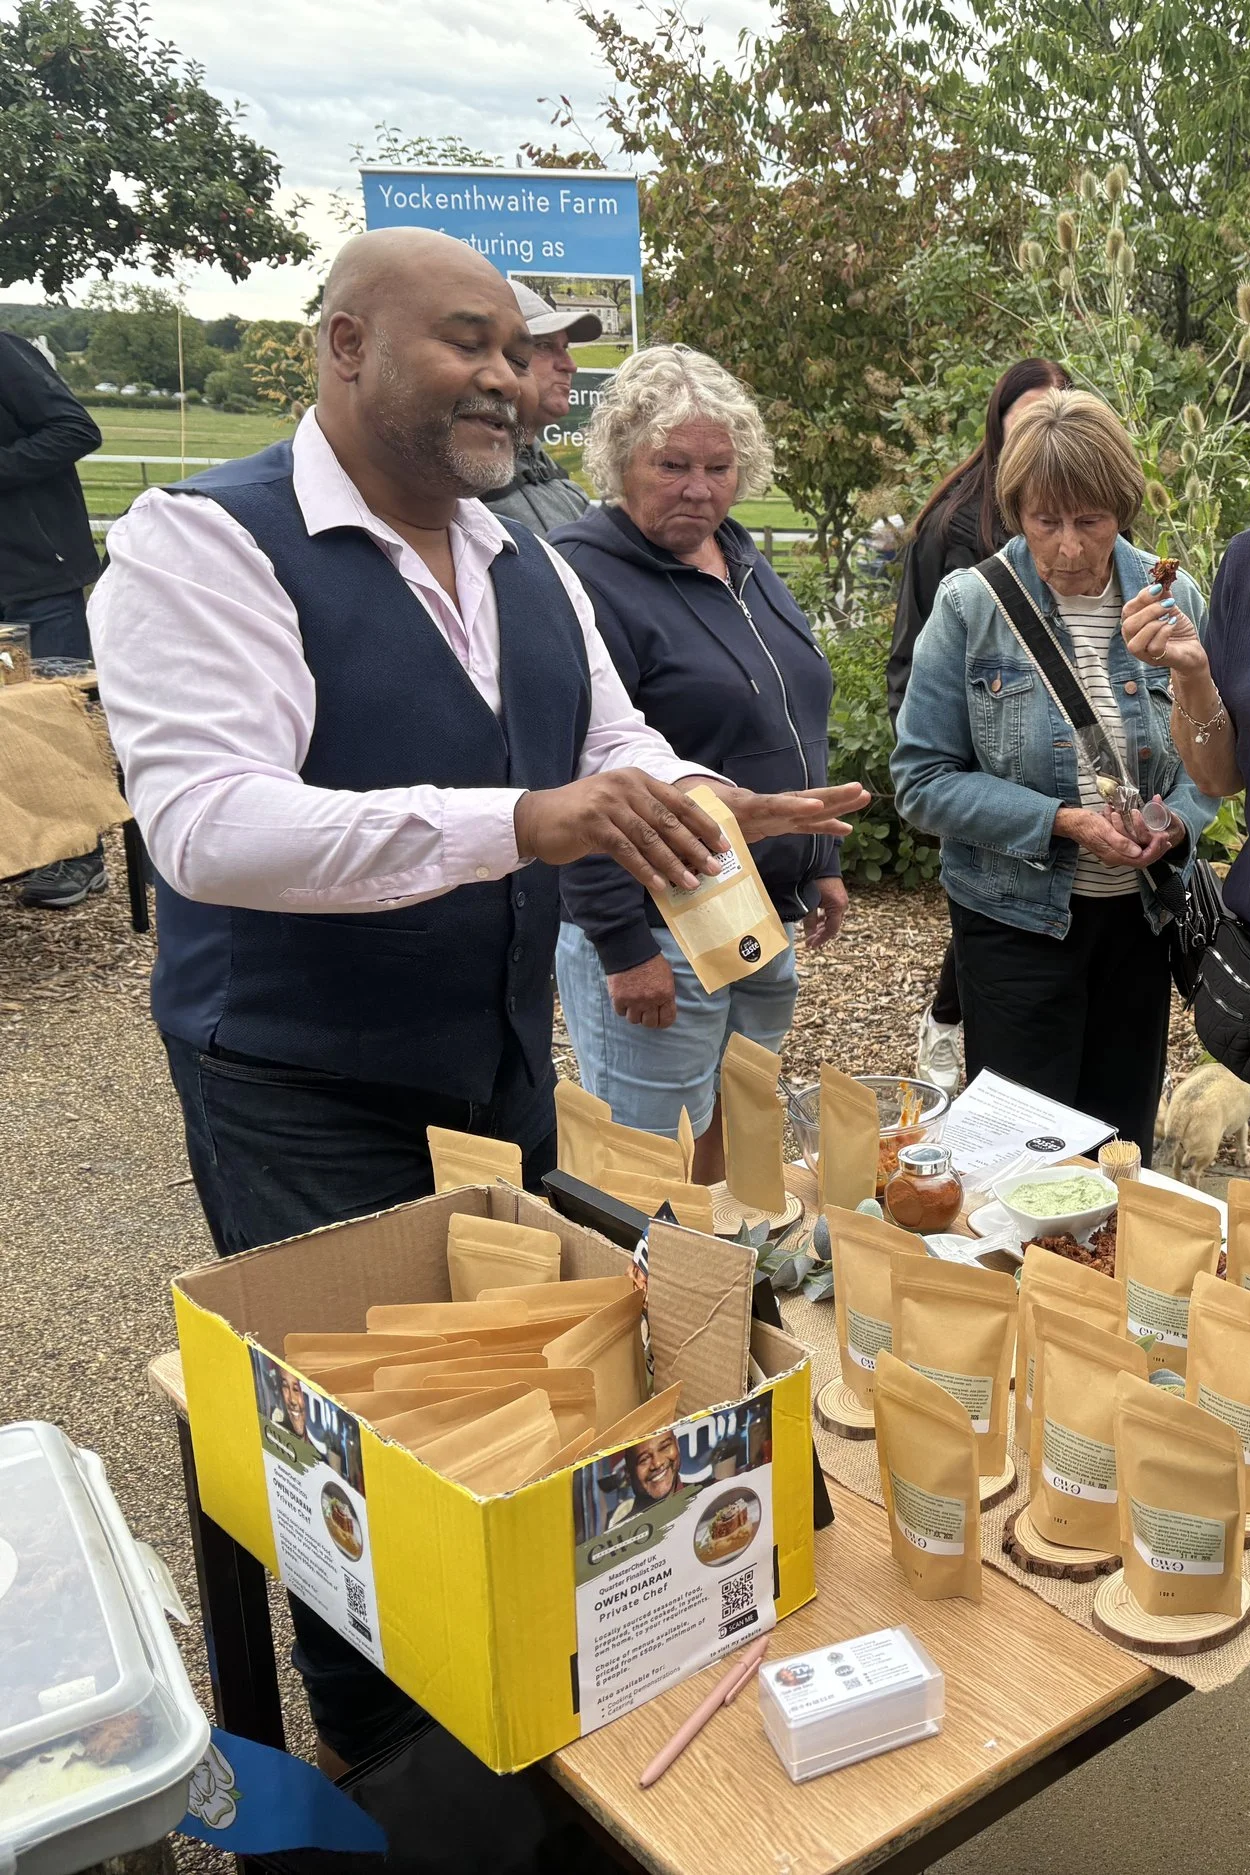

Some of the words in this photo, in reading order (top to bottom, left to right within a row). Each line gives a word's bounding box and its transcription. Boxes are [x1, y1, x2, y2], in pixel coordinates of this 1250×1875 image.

[379, 183, 550, 212] Yockenthwaite
[559, 189, 618, 215] Farm
[542, 240, 565, 257] as
[568, 389, 605, 405] arm
[1054, 1476, 1080, 1494] CWO
[599, 1580, 625, 1596] Quarter
[626, 1568, 650, 1582] Finalist
[650, 1559, 666, 1572] 2023
[608, 1560, 648, 1582] MasterChef
[648, 1554, 657, 1564] UK
[1150, 1557, 1184, 1572] CWO
[594, 1589, 628, 1611] OWEN
[630, 1568, 672, 1595] DIARAM
[600, 1598, 640, 1622] Private
[643, 1582, 668, 1601] Chef
[594, 1625, 621, 1643] Locally
[623, 1611, 652, 1628] sourced
[653, 1595, 683, 1614] seasonal
[685, 1585, 703, 1598] food,
[594, 1631, 630, 1652] prepared,
[632, 1620, 648, 1632] then
[650, 1606, 678, 1622] cooked,
[687, 1592, 703, 1605] your
[612, 1637, 634, 1649] home,
[644, 1621, 661, 1634] your
[662, 1596, 710, 1622] requirements.
[728, 1619, 744, 1632] SCAN
[745, 1614, 755, 1622] ME
[596, 1656, 620, 1672] Choice
[632, 1638, 654, 1653] menus
[656, 1621, 690, 1640] available,
[596, 1663, 619, 1681] priced
[620, 1654, 638, 1666] from
[666, 1624, 696, 1642] minimum
[718, 1644, 730, 1655] visit
[740, 1628, 762, 1641] website
[598, 1692, 614, 1704] Also
[616, 1672, 650, 1695] available
[652, 1664, 666, 1676] for:
[602, 1667, 630, 1684] people.
[608, 1692, 632, 1709] Cooking
[634, 1666, 680, 1695] Demonstrations
[608, 1698, 634, 1716] Catering
